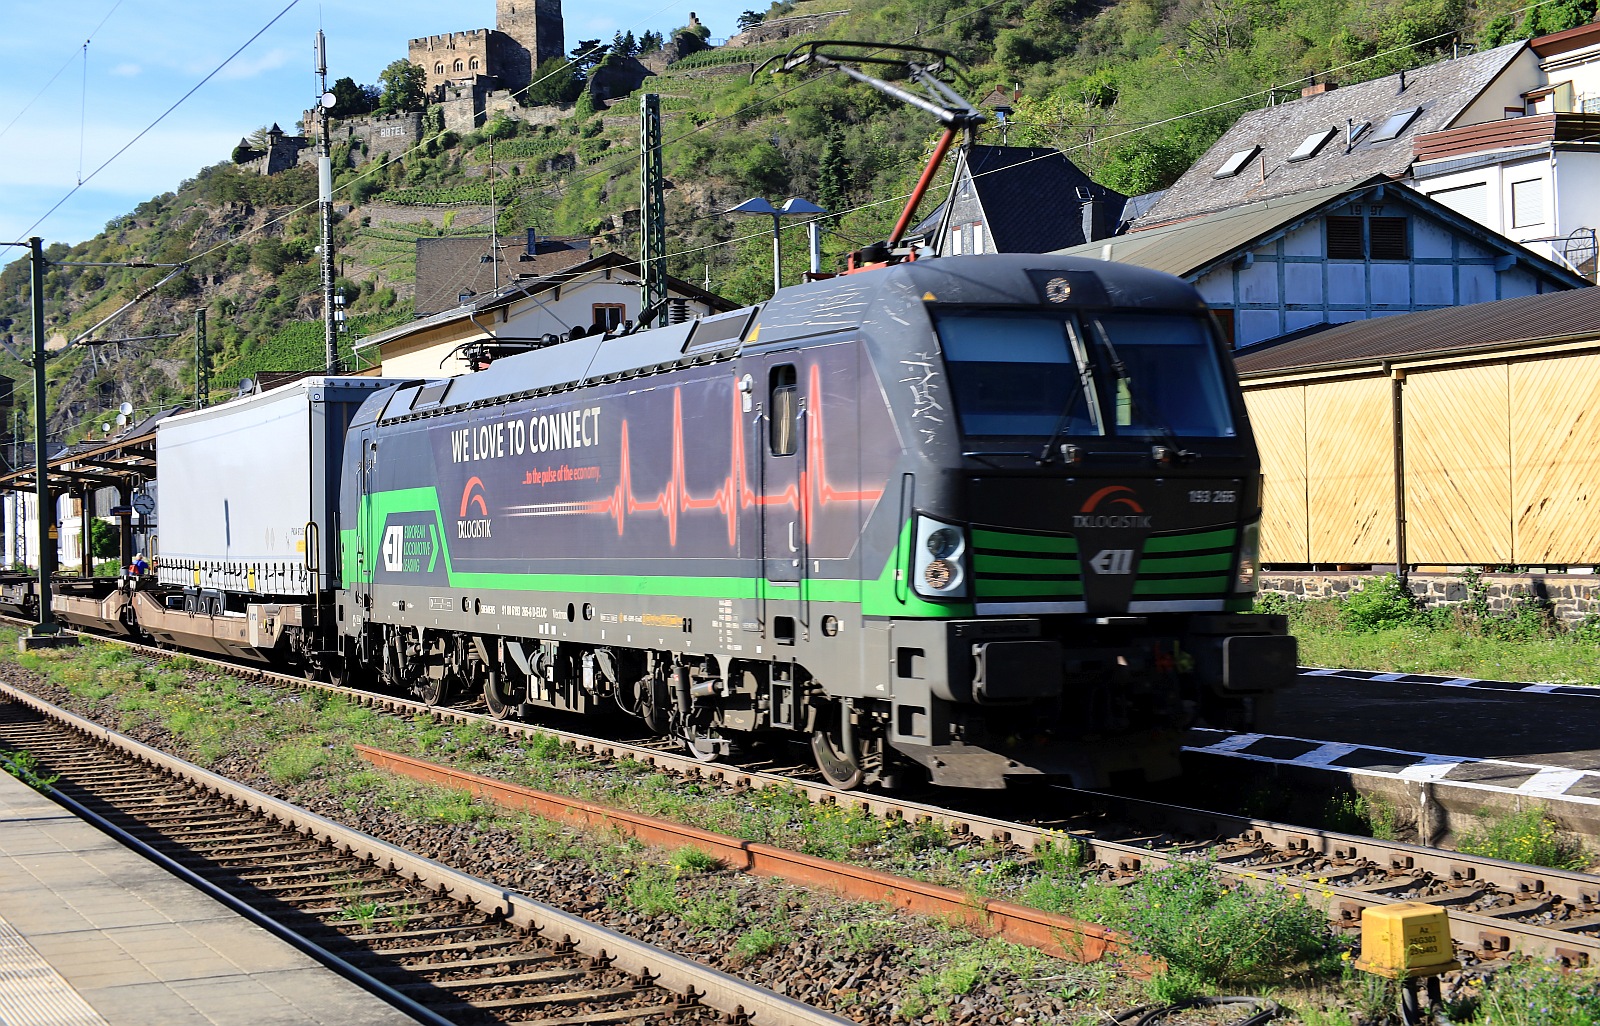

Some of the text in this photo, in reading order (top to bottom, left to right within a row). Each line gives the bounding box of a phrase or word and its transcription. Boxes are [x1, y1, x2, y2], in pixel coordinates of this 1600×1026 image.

[381, 126, 405, 138] HOTEL
[451, 406, 601, 463] WE LOVE TO CONNECT
[532, 467, 541, 484] the
[541, 466, 556, 487] pulse
[557, 464, 564, 481] of
[563, 464, 573, 481] the
[1188, 490, 1236, 503] 193 265
[404, 524, 426, 539] EUROPEAN
[403, 541, 431, 556] LOCOMOTIVE
[402, 558, 420, 573] LEASING
